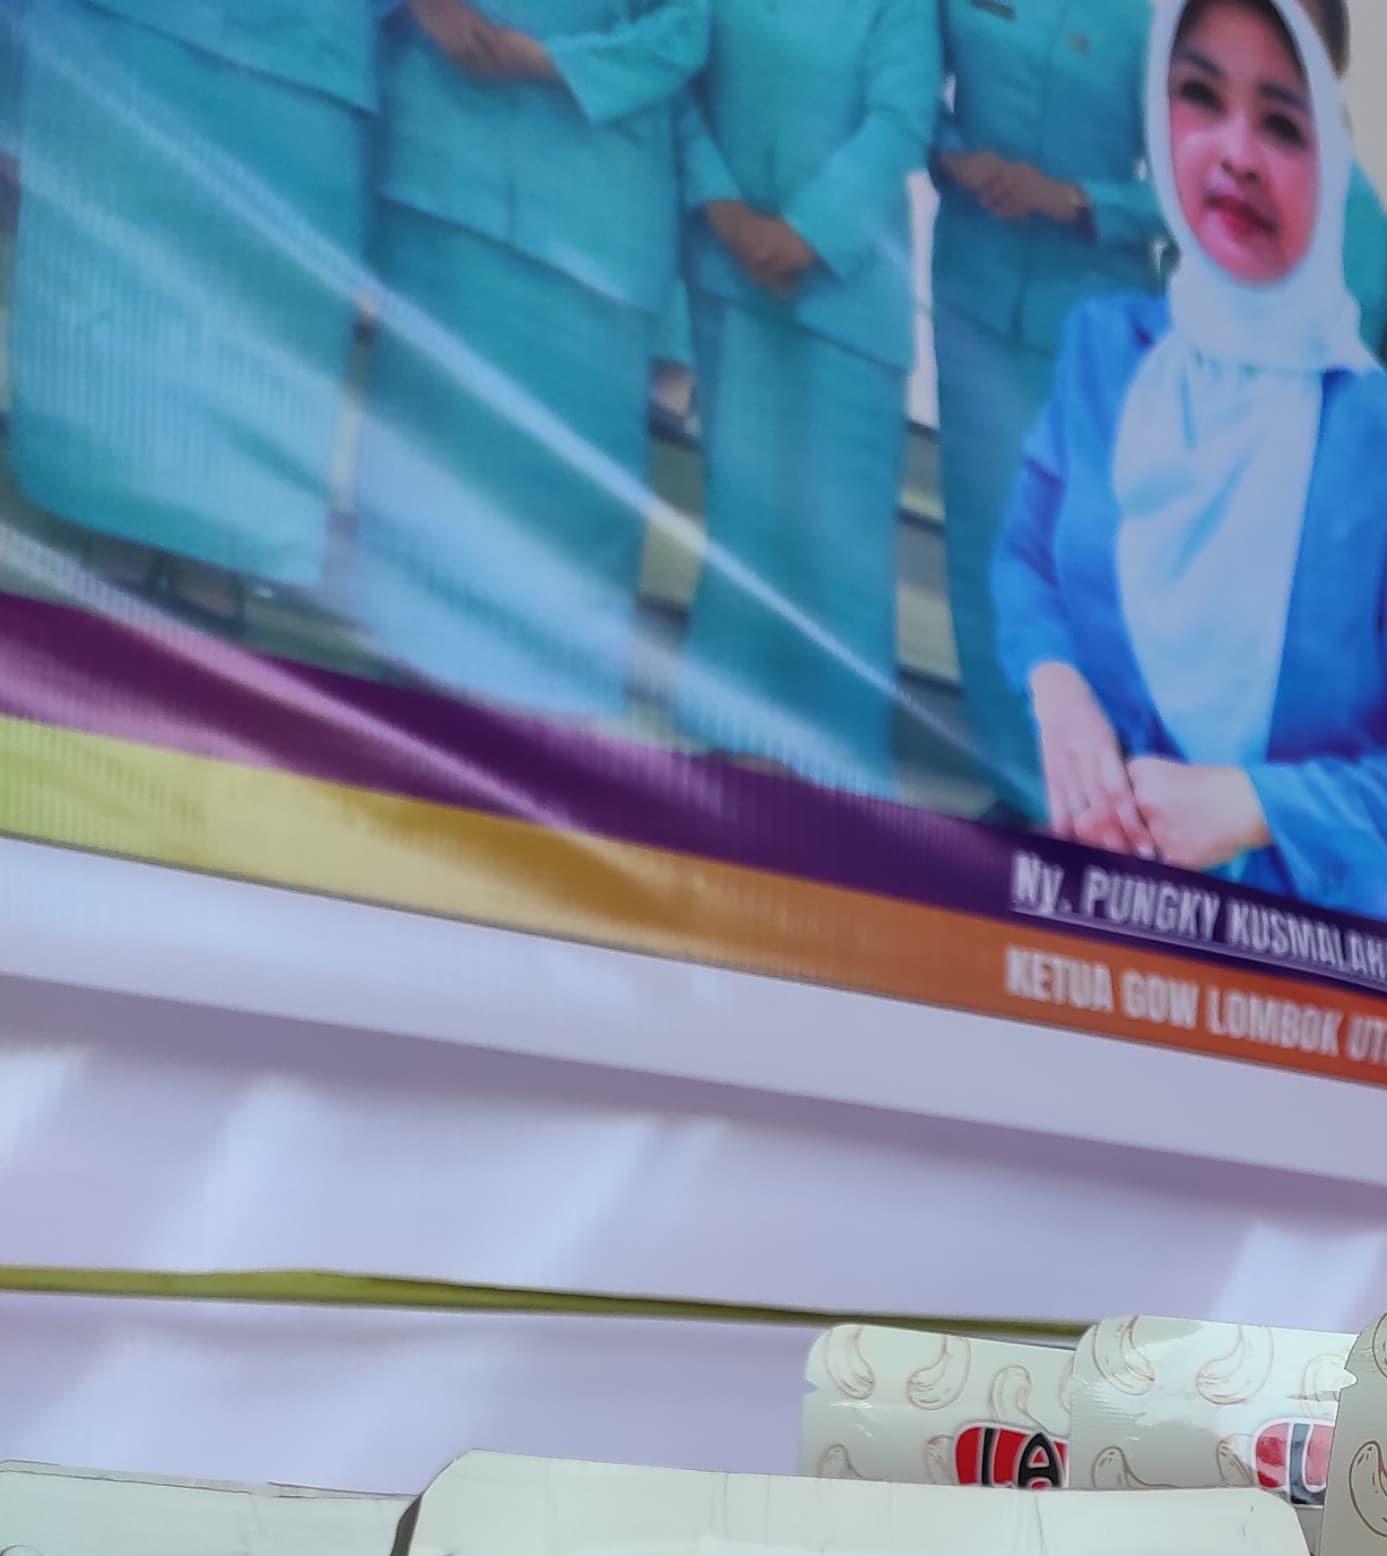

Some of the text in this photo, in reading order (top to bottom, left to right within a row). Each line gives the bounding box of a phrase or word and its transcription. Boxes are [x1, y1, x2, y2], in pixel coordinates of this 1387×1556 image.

[1012, 850, 1072, 910] Ny.
[1084, 869, 1222, 944] PUNGKY
[1005, 944, 1115, 1015] KETUA
[1122, 967, 1200, 1030] GOW
[1206, 982, 1342, 1057] LOMBOK
